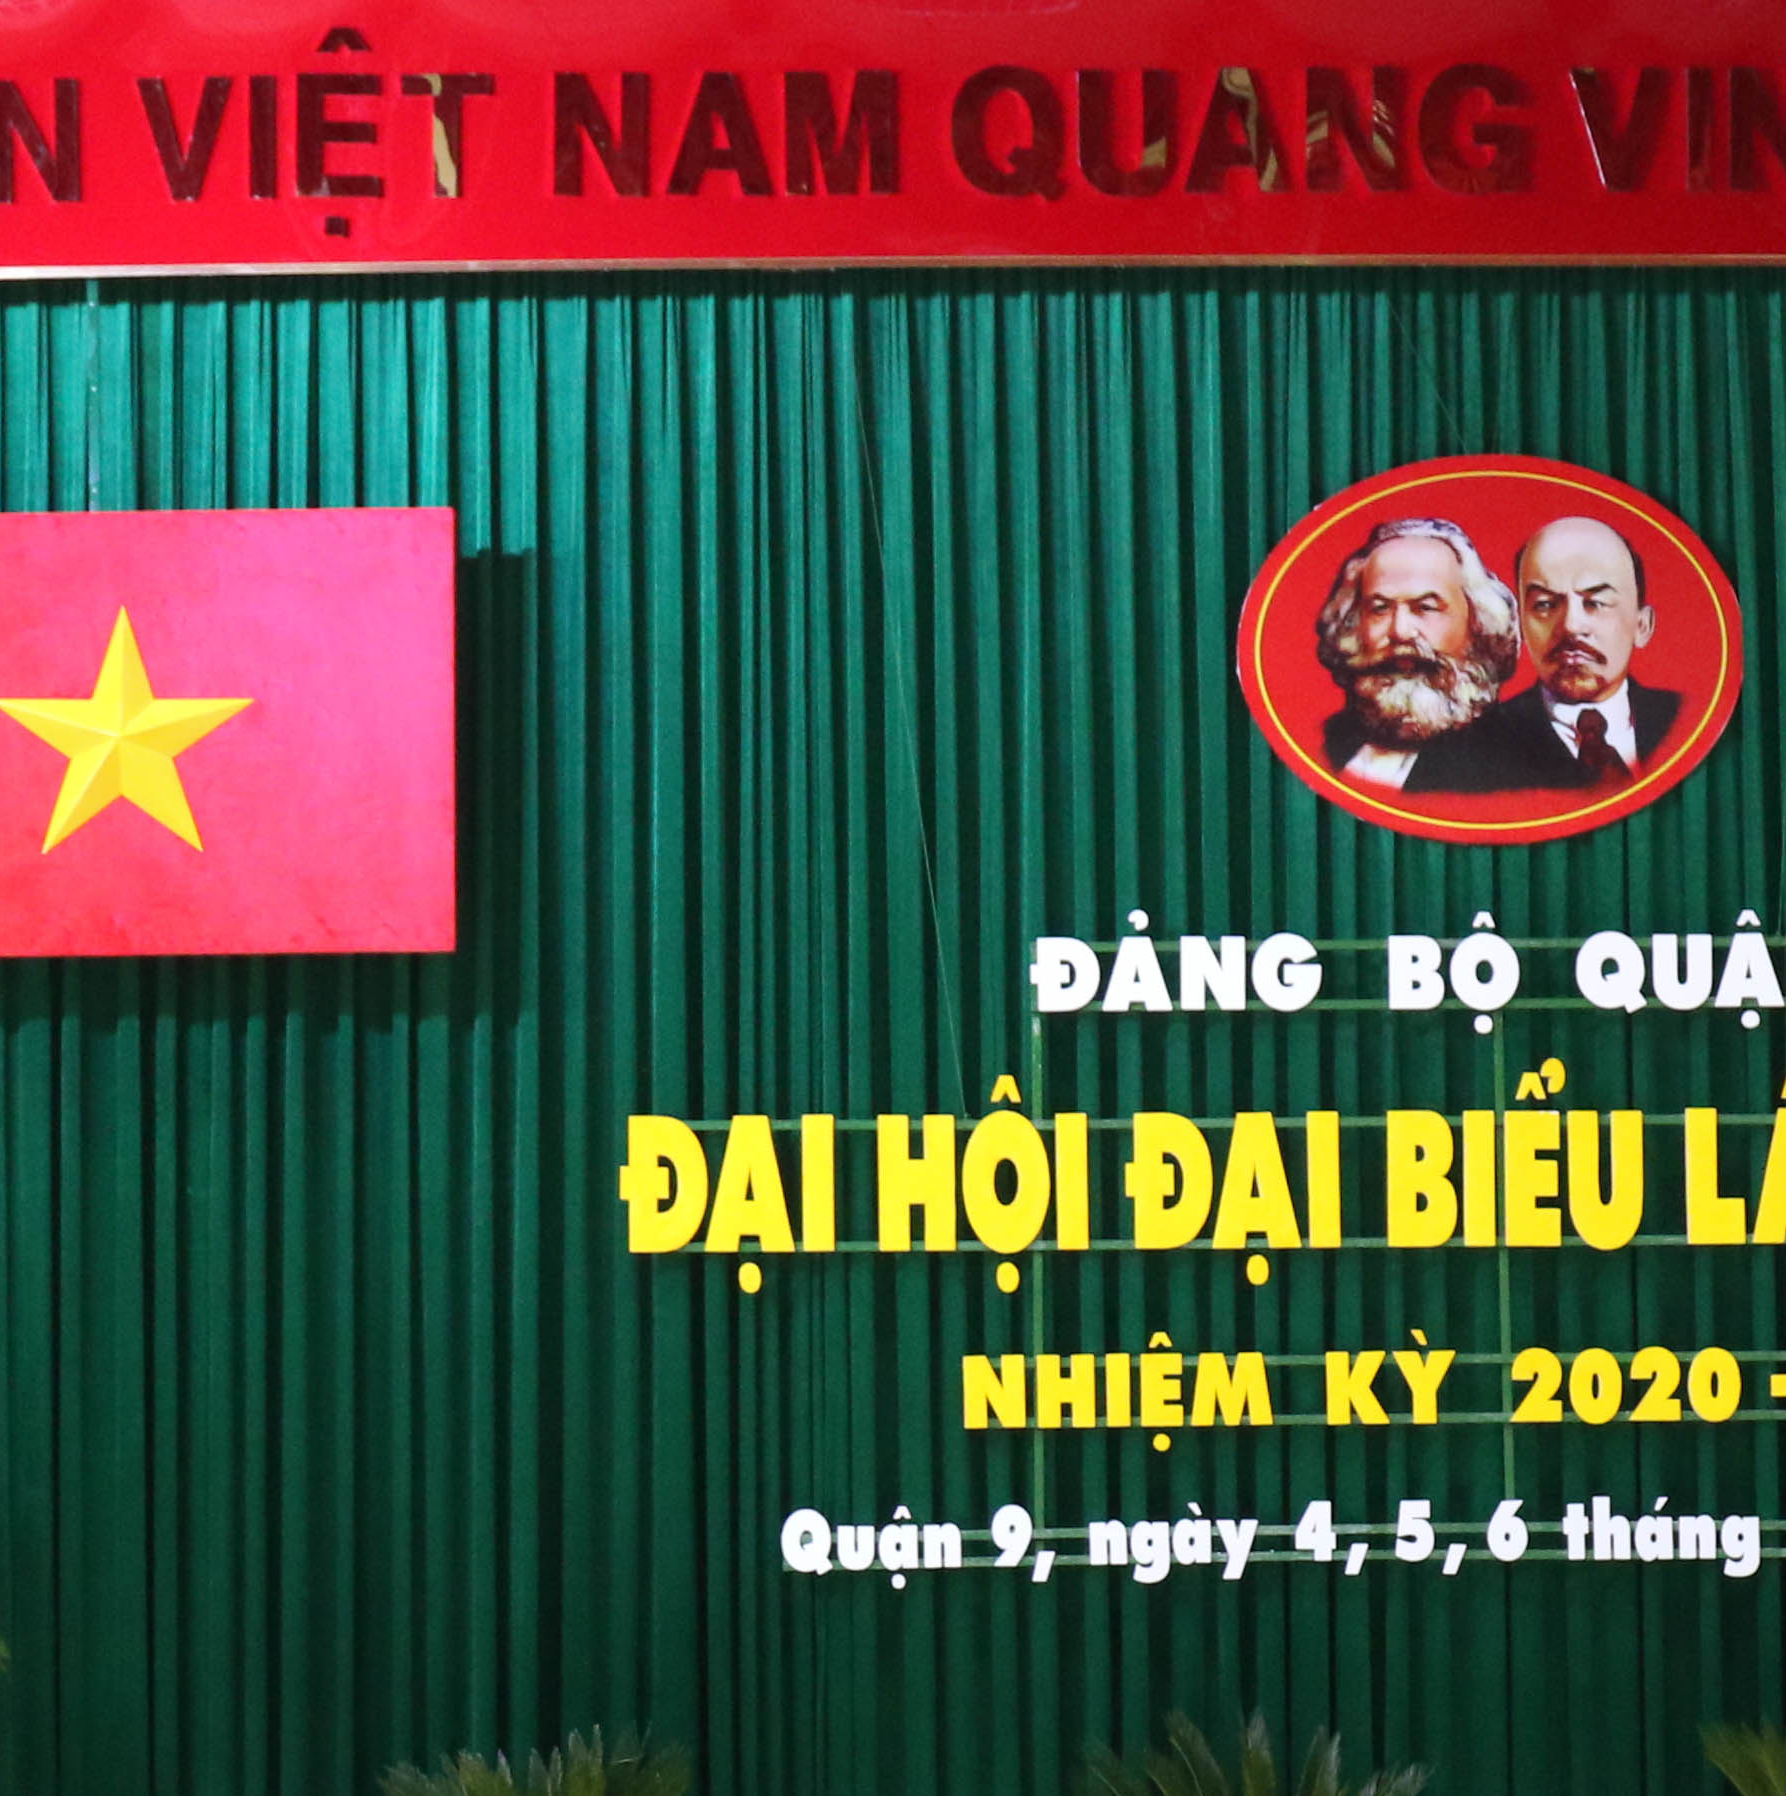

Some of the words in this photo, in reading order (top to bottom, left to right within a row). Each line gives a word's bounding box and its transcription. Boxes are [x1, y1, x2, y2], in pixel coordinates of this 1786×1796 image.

[136, 26, 496, 240] VIỆT
[552, 68, 902, 198] NAM
[949, 64, 1536, 202] QUANG
[1029, 909, 1322, 1013] ĐẢNG
[1387, 924, 1519, 1034] BỘ
[619, 1112, 836, 1294] ĐẠI
[876, 1074, 1090, 1293] HỘI
[1124, 1110, 1342, 1287] ĐẠI
[1385, 1057, 1645, 1252] BIỂU
[962, 1331, 1274, 1452] NHIỆM
[1324, 1329, 1457, 1427] KỲ
[1510, 1346, 1742, 1425] 2020
[780, 1505, 963, 1590] Quận
[990, 1504, 1056, 1583] 9,
[1088, 1502, 1259, 1584] ngày
[1294, 1500, 1369, 1576] 4,
[1394, 1499, 1467, 1576] 5,
[1487, 1499, 1528, 1563] 6
[1561, 1495, 1762, 1578] tháng
